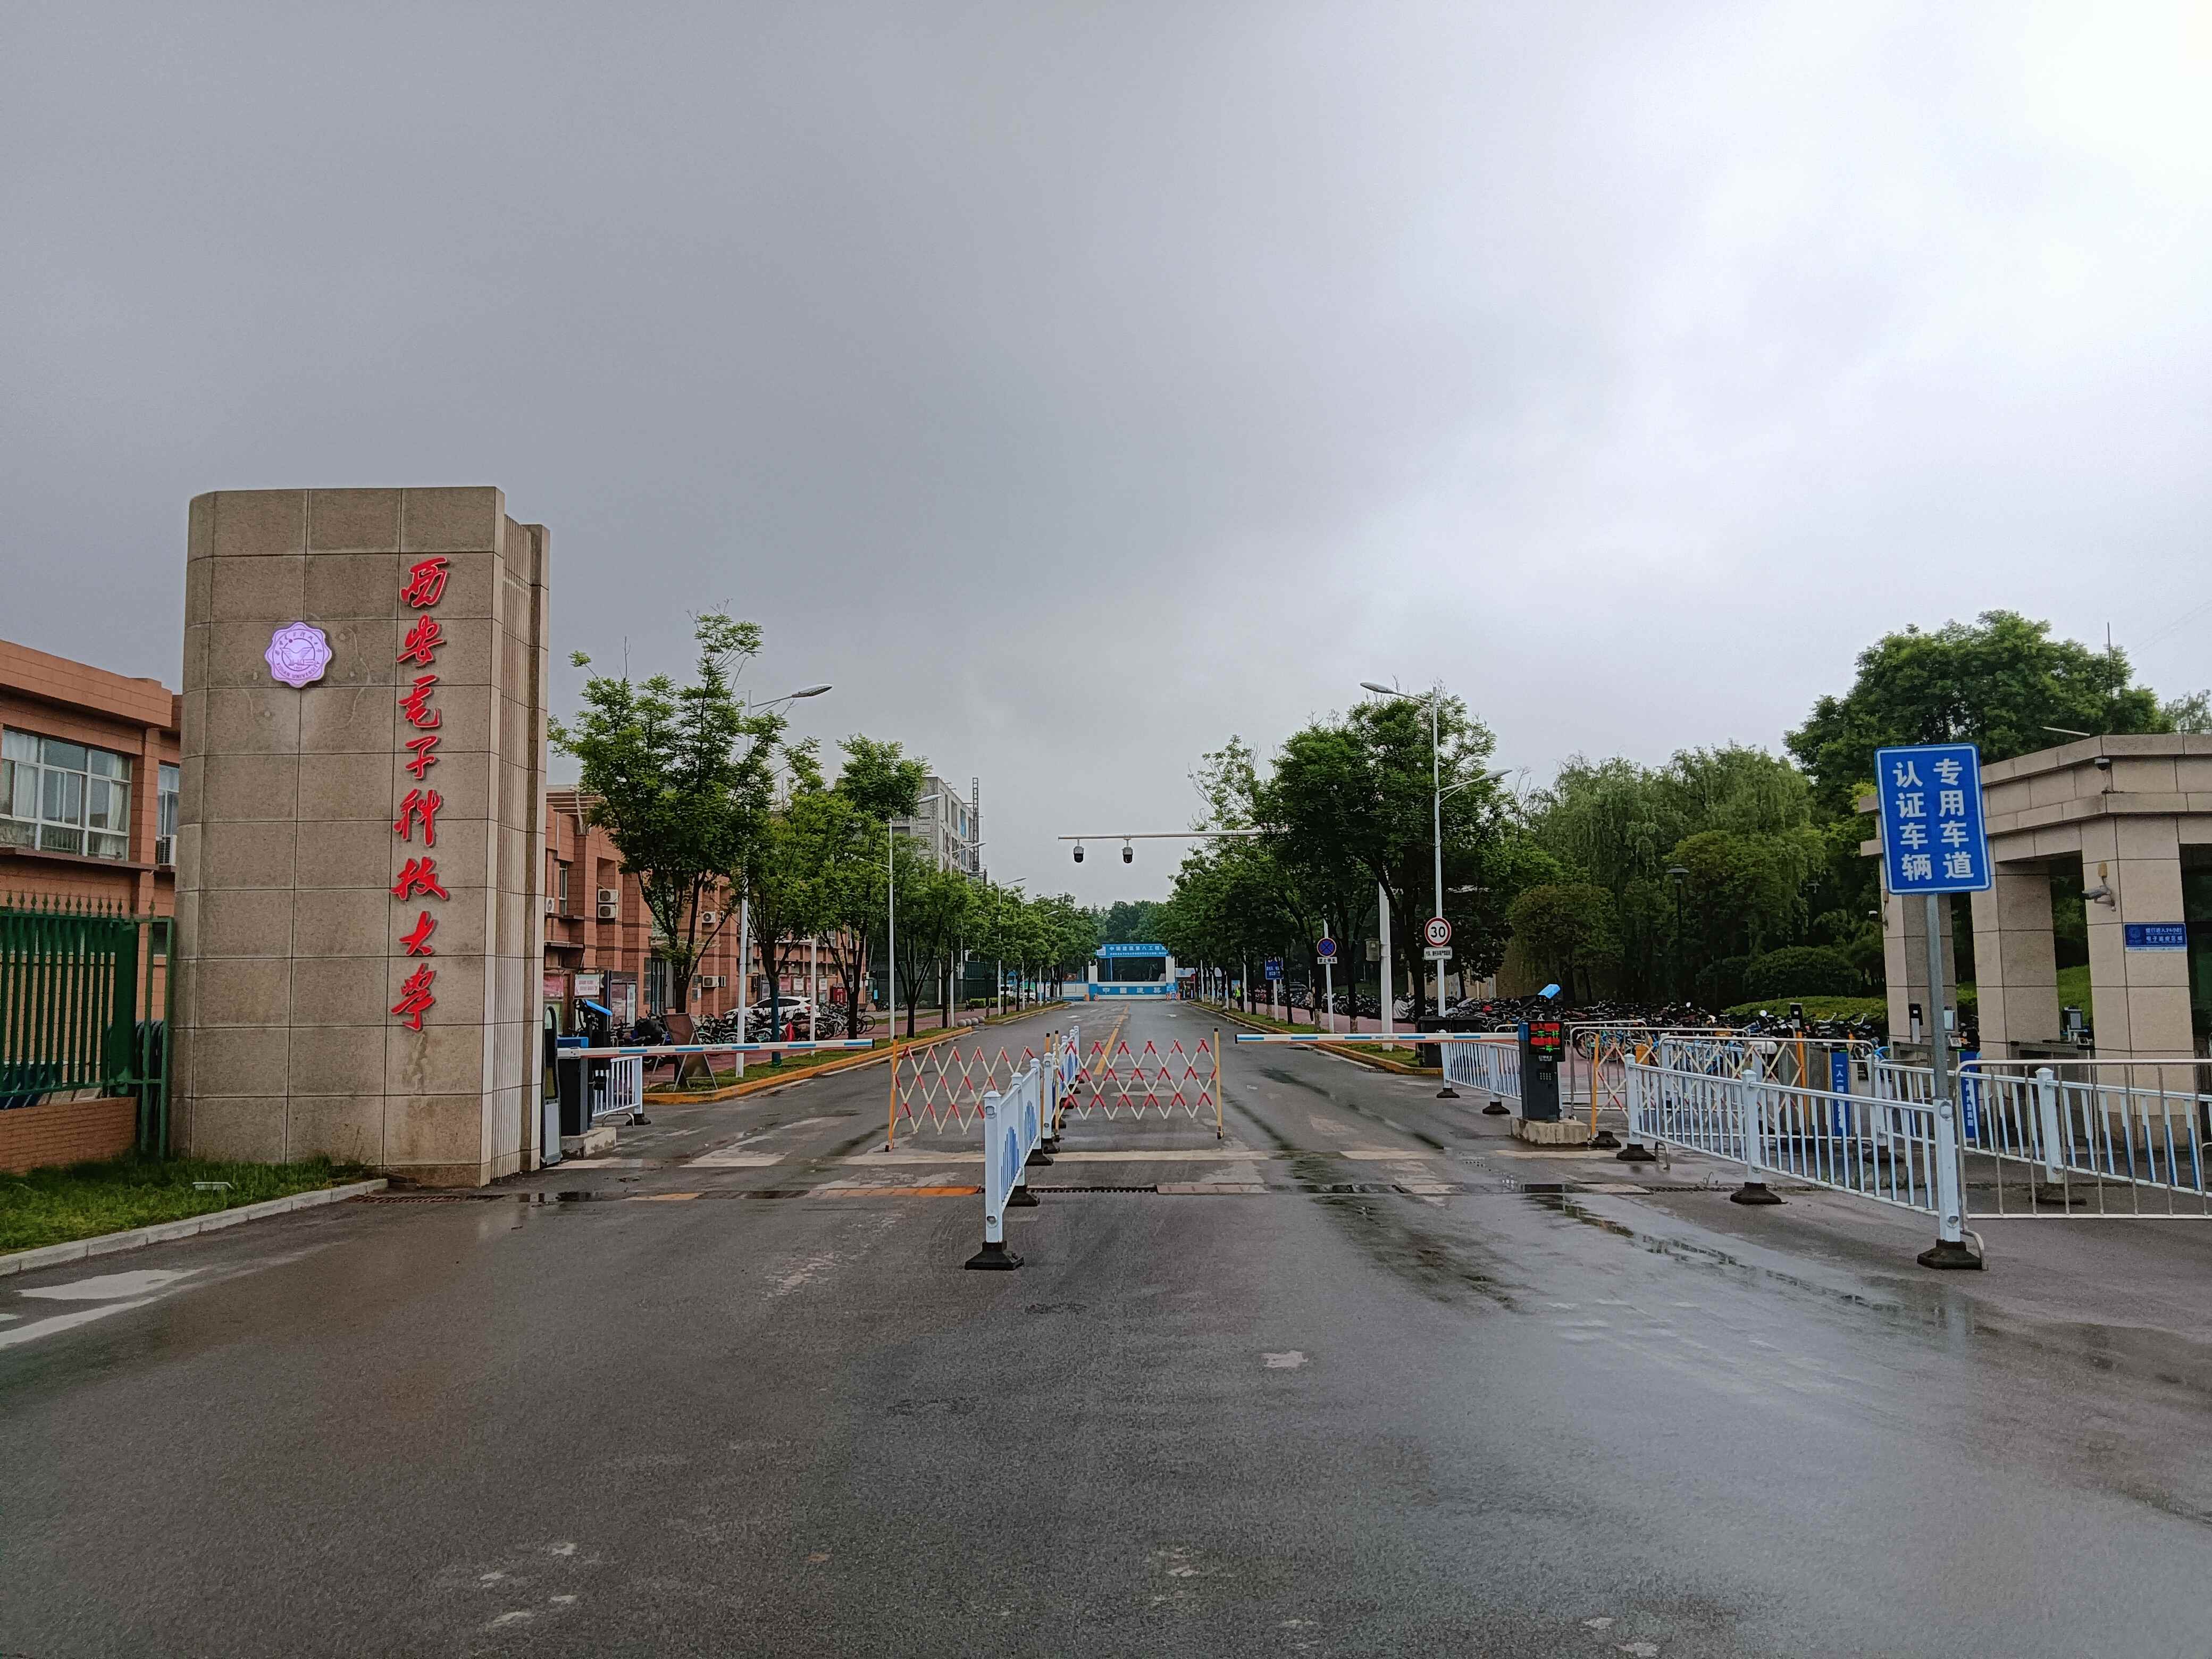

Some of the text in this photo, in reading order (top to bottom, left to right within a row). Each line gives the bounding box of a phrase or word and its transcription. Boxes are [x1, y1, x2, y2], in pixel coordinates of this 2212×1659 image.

[1892, 760, 1933, 882] 认证车辆
[1932, 758, 1975, 879] 专用车道
[1430, 926, 1446, 938] 30
